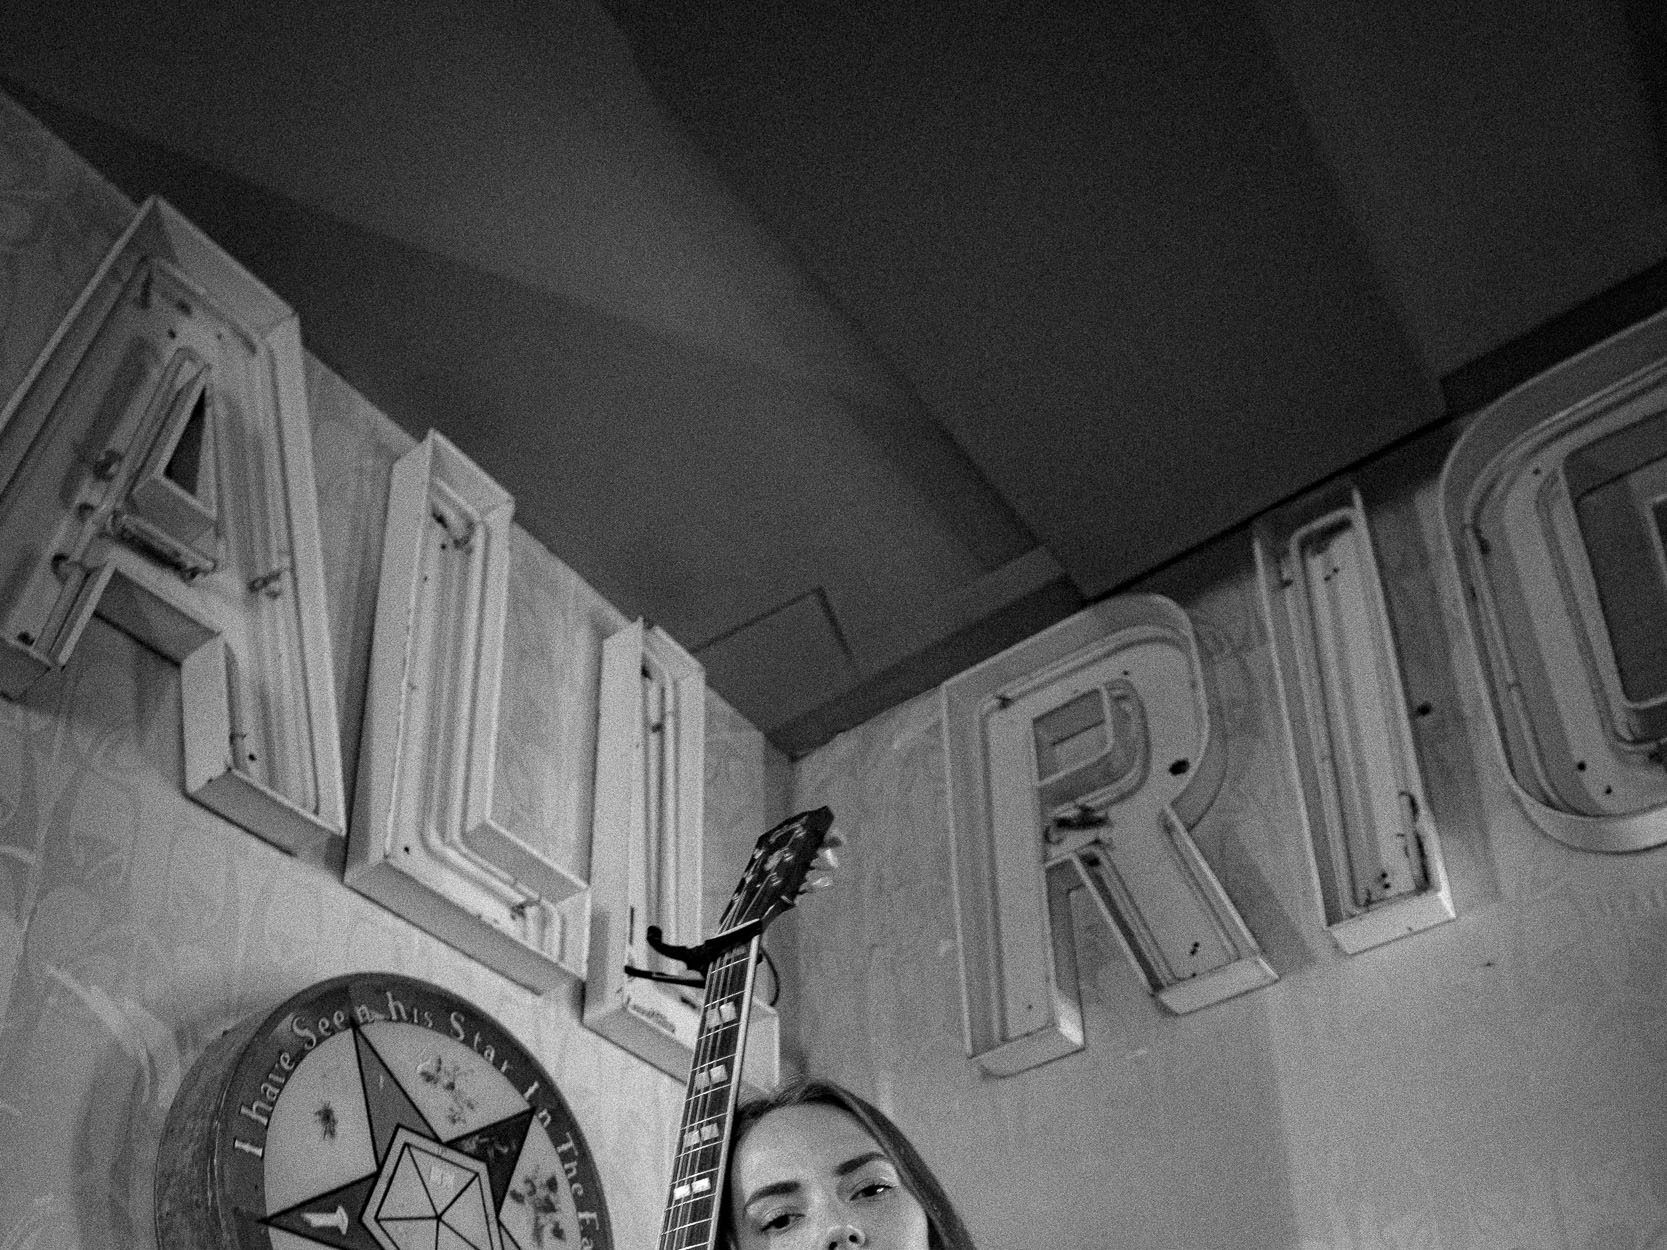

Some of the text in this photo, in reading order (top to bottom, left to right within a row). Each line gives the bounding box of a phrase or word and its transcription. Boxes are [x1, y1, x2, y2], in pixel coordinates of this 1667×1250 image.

[233, 1137, 264, 1159] I
[449, 1010, 510, 1074] Star
[555, 1131, 585, 1198] The
